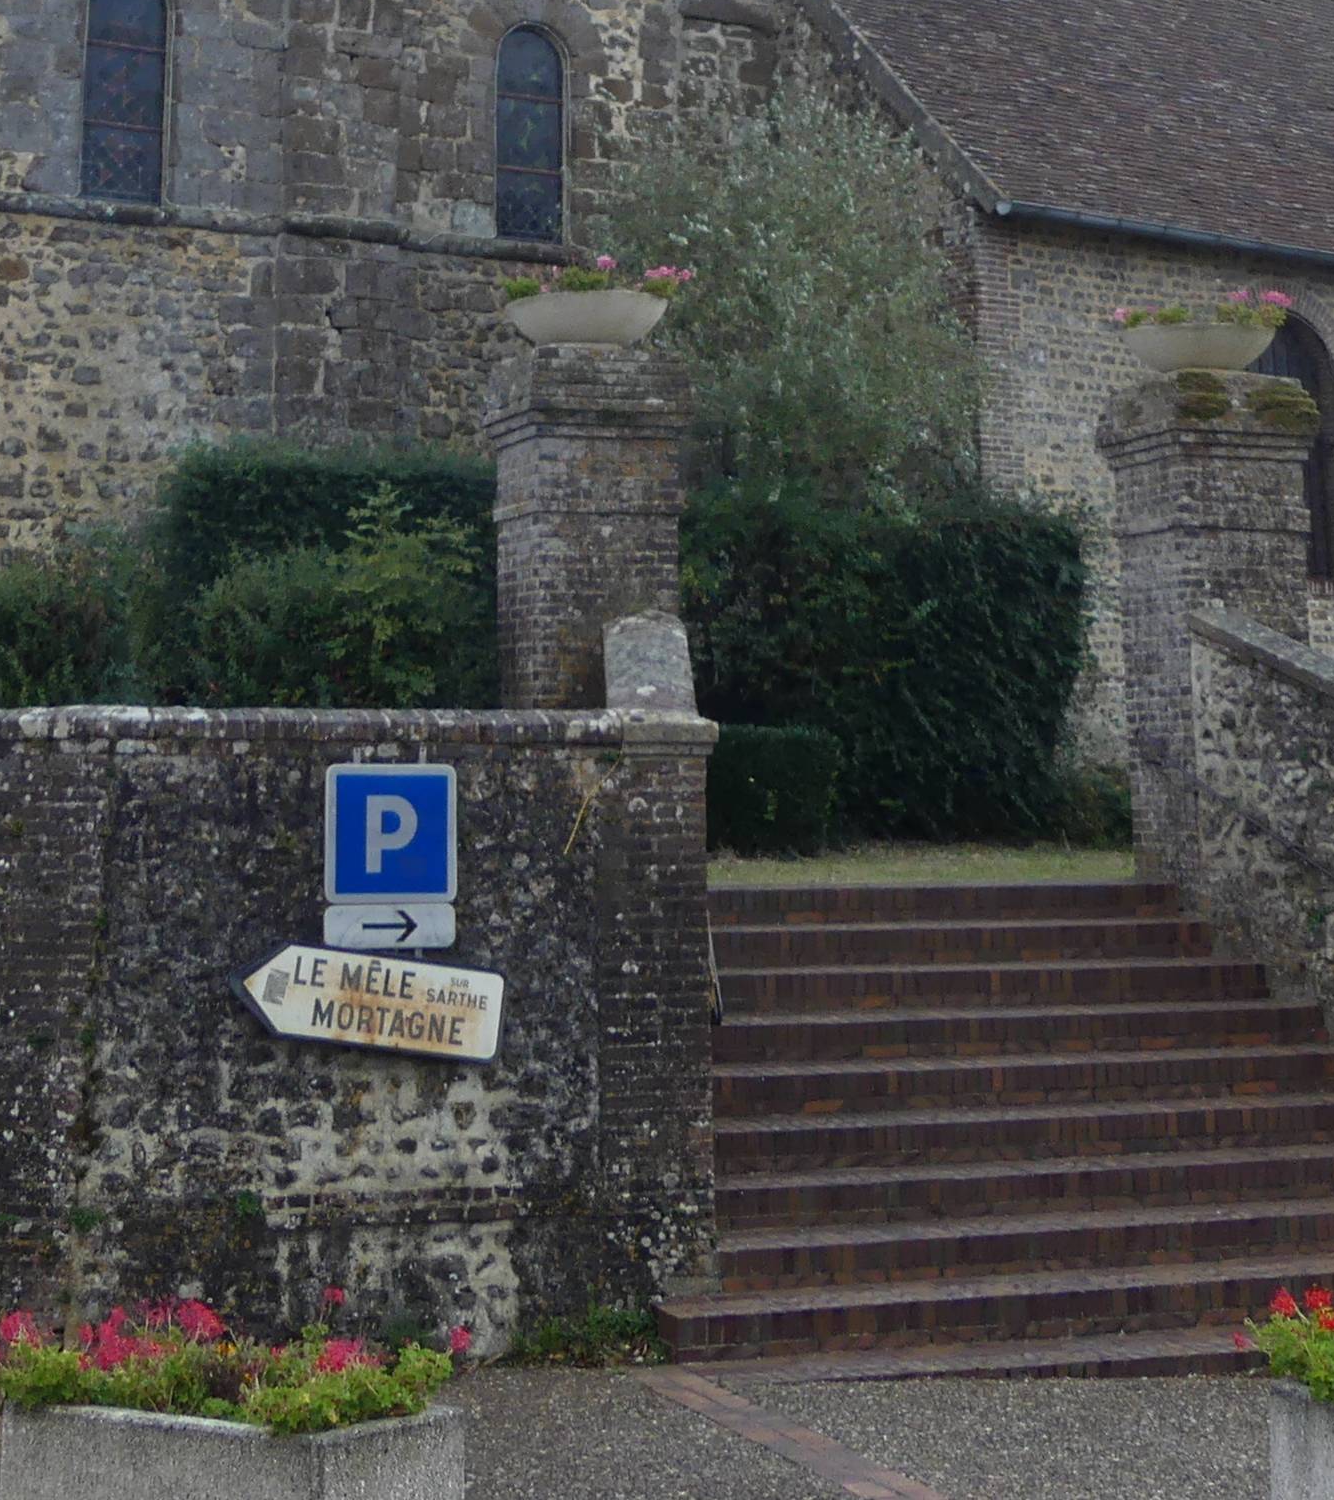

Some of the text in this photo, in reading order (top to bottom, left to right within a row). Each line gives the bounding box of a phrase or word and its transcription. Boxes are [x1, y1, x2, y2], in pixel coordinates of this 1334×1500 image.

[366, 794, 417, 873] P
[293, 955, 469, 1000] LE MÊLE SUR
[426, 988, 489, 1011] SARTHE
[311, 997, 466, 1045] MORTAGNE
